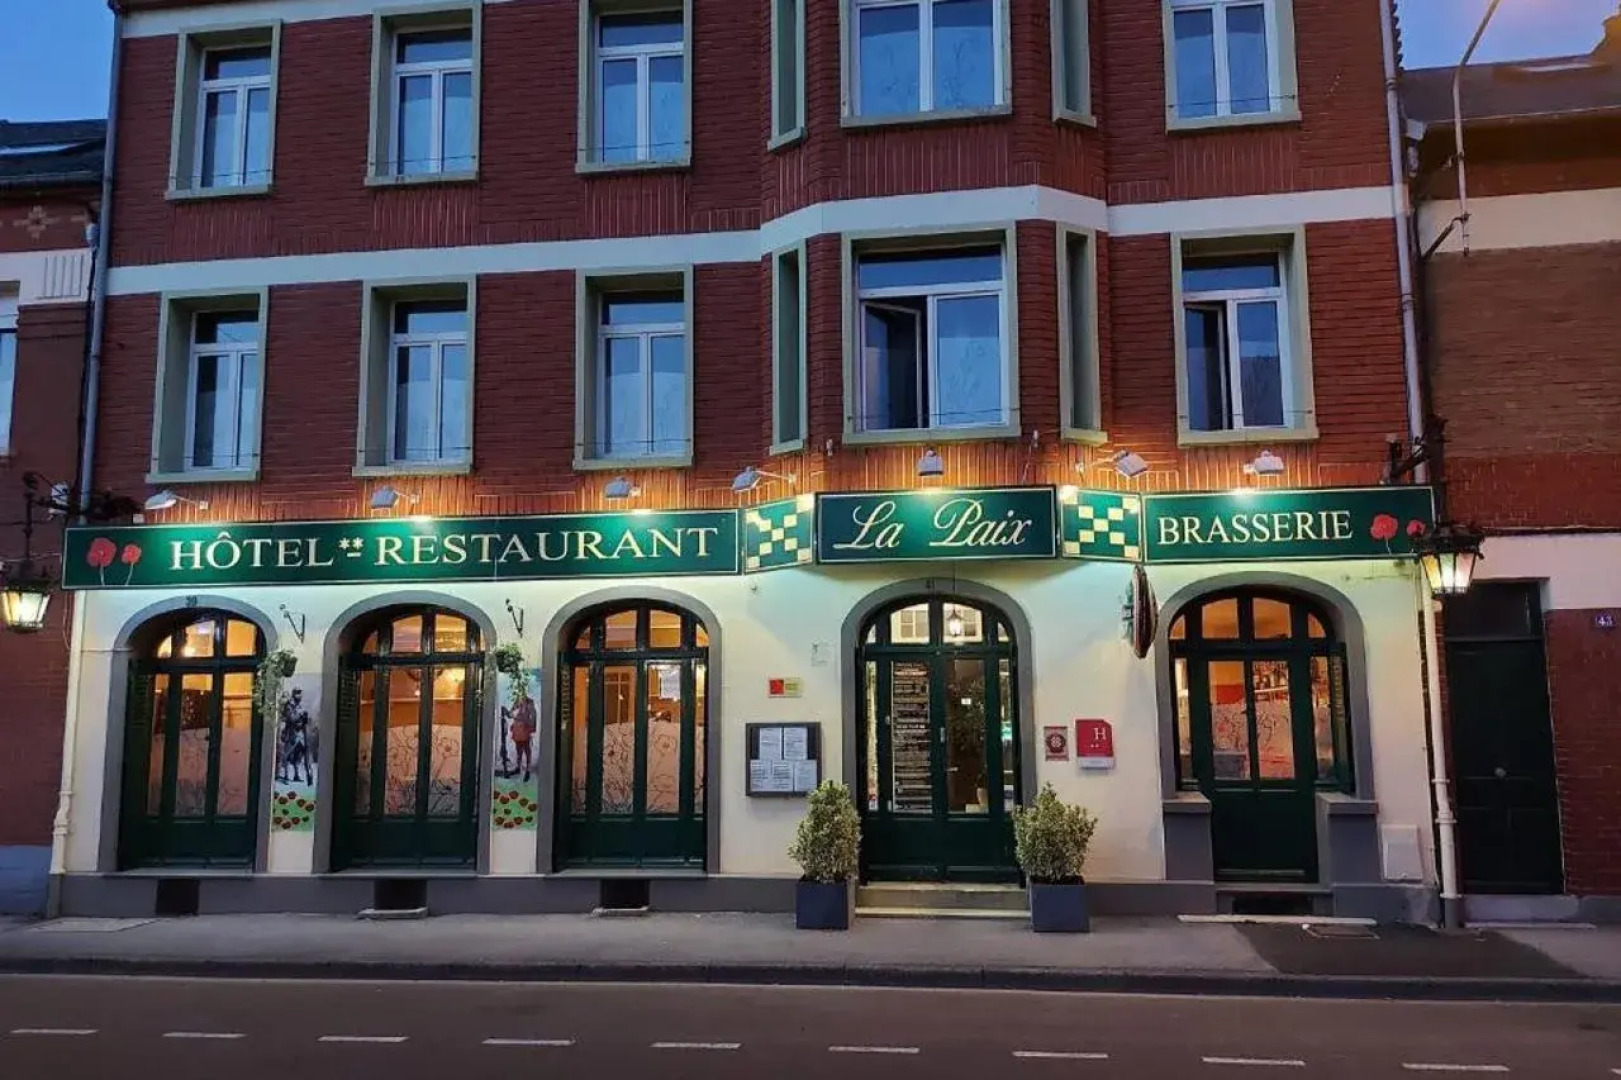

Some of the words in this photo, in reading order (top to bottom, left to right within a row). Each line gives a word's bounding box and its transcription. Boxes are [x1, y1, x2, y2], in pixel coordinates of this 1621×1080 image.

[833, 500, 904, 549] La
[929, 498, 1032, 547] Paix
[1157, 511, 1353, 545] BRASSERIE
[169, 532, 333, 570] HÔTEL
[373, 527, 718, 565] RESTAURANT
[1093, 727, 1107, 740] H
